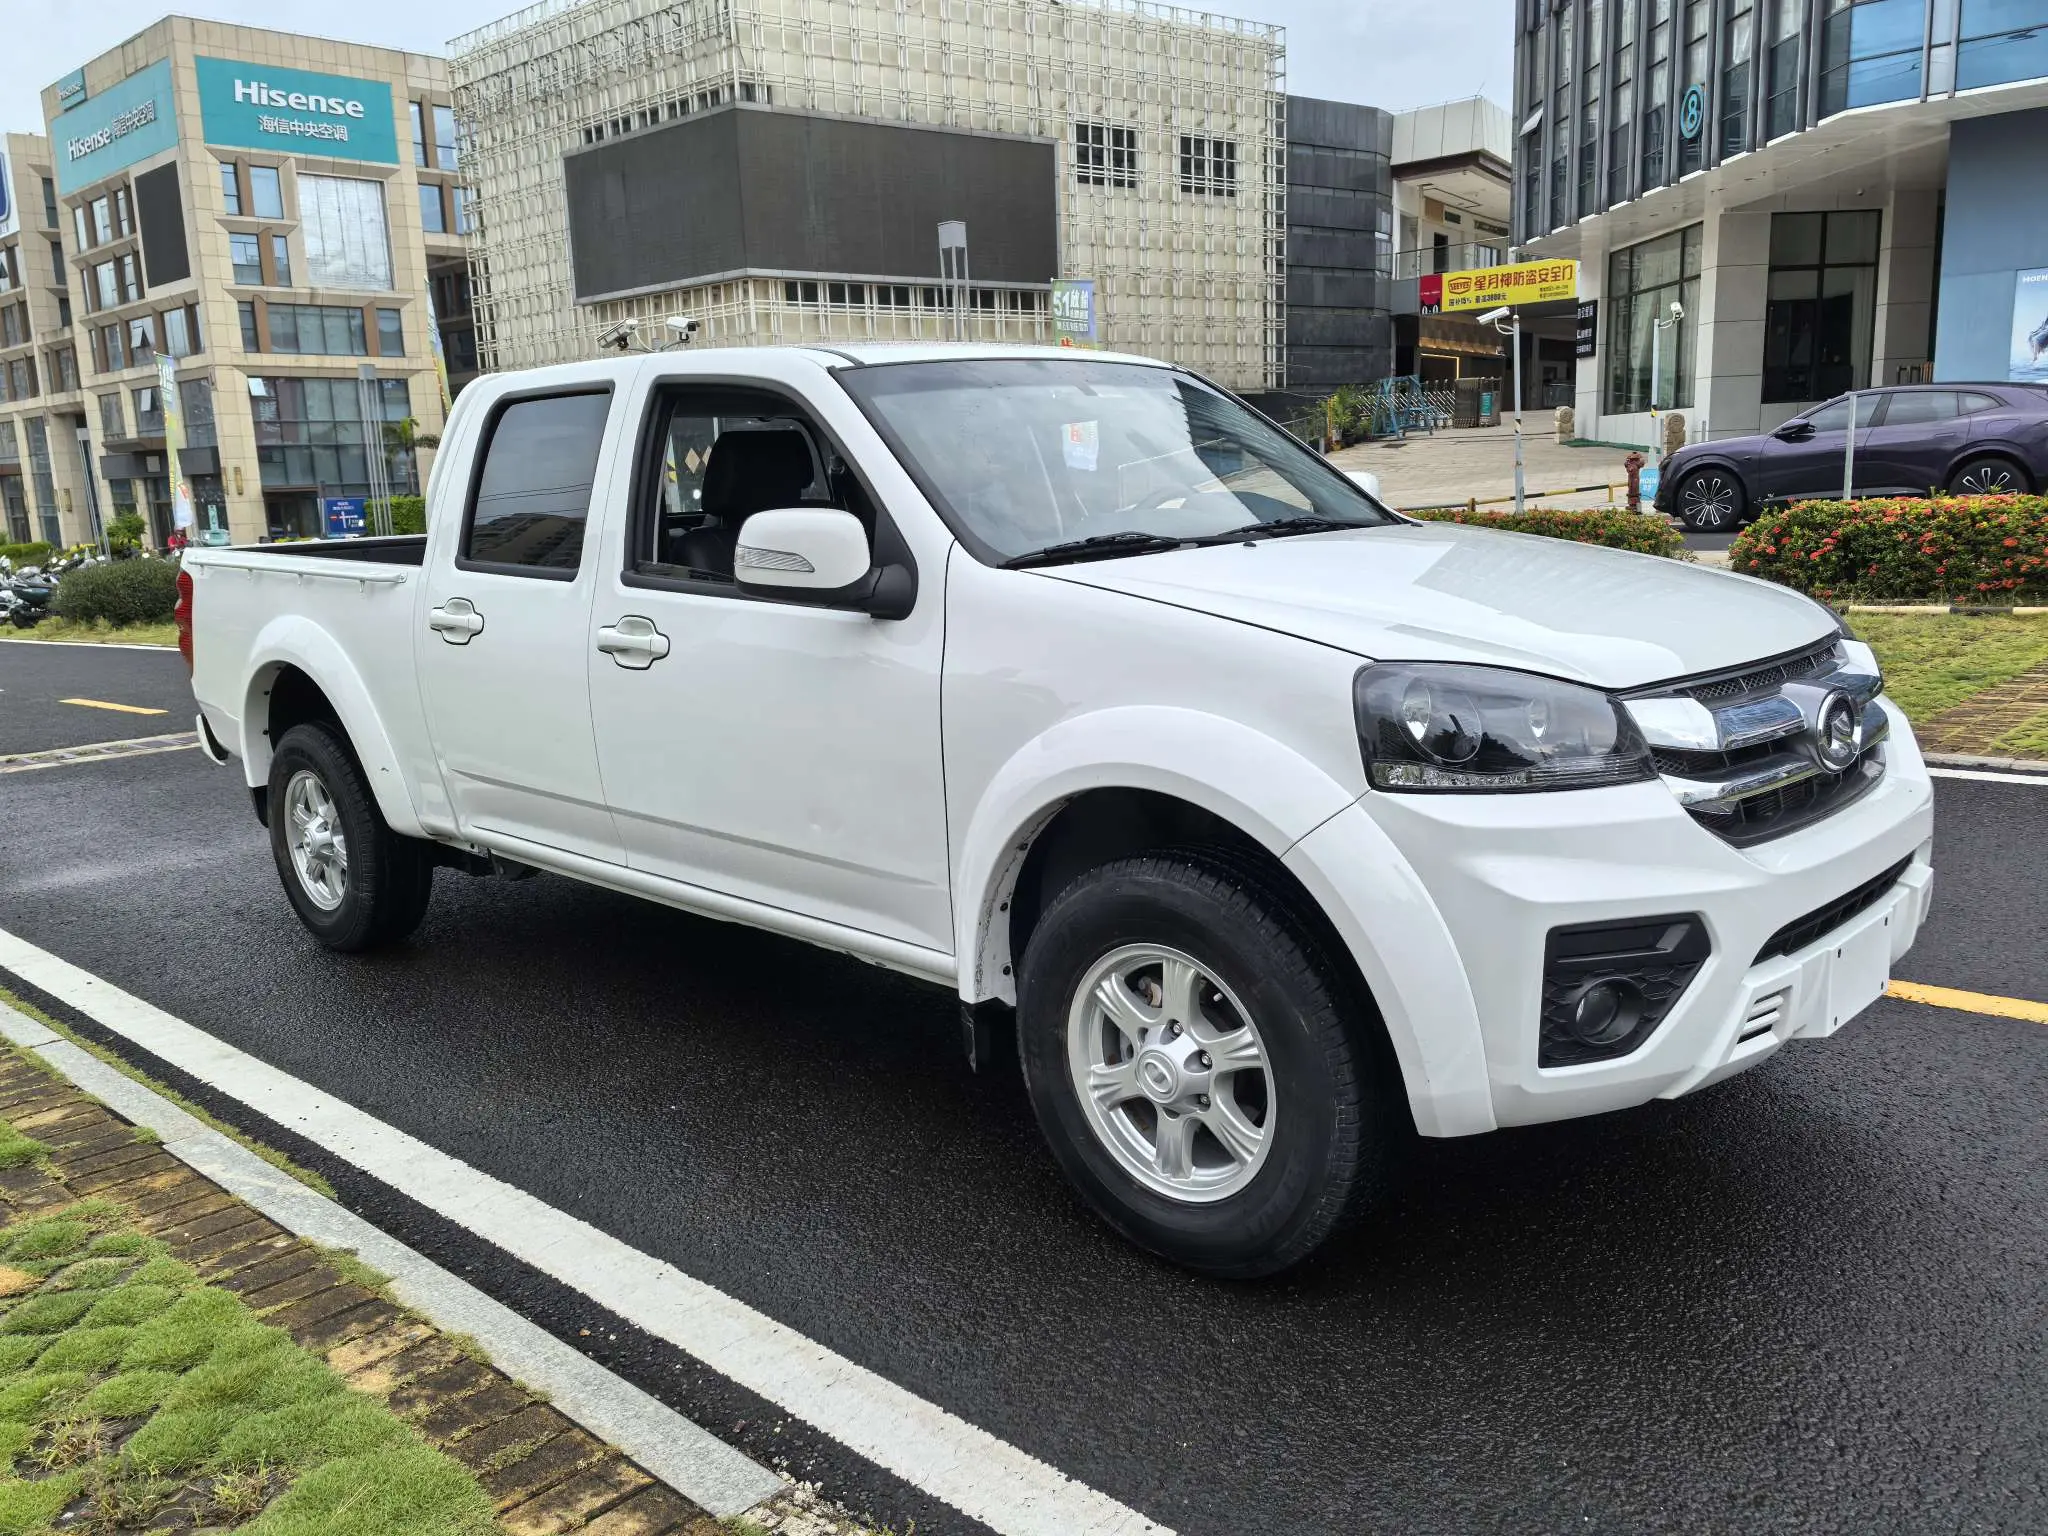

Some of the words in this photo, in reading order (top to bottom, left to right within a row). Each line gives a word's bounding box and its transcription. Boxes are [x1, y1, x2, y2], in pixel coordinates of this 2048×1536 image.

[234, 79, 364, 118] Hisense
[67, 127, 112, 161] Hisense
[111, 99, 155, 138] 海信中央空调
[258, 115, 348, 142] 海信中央空调
